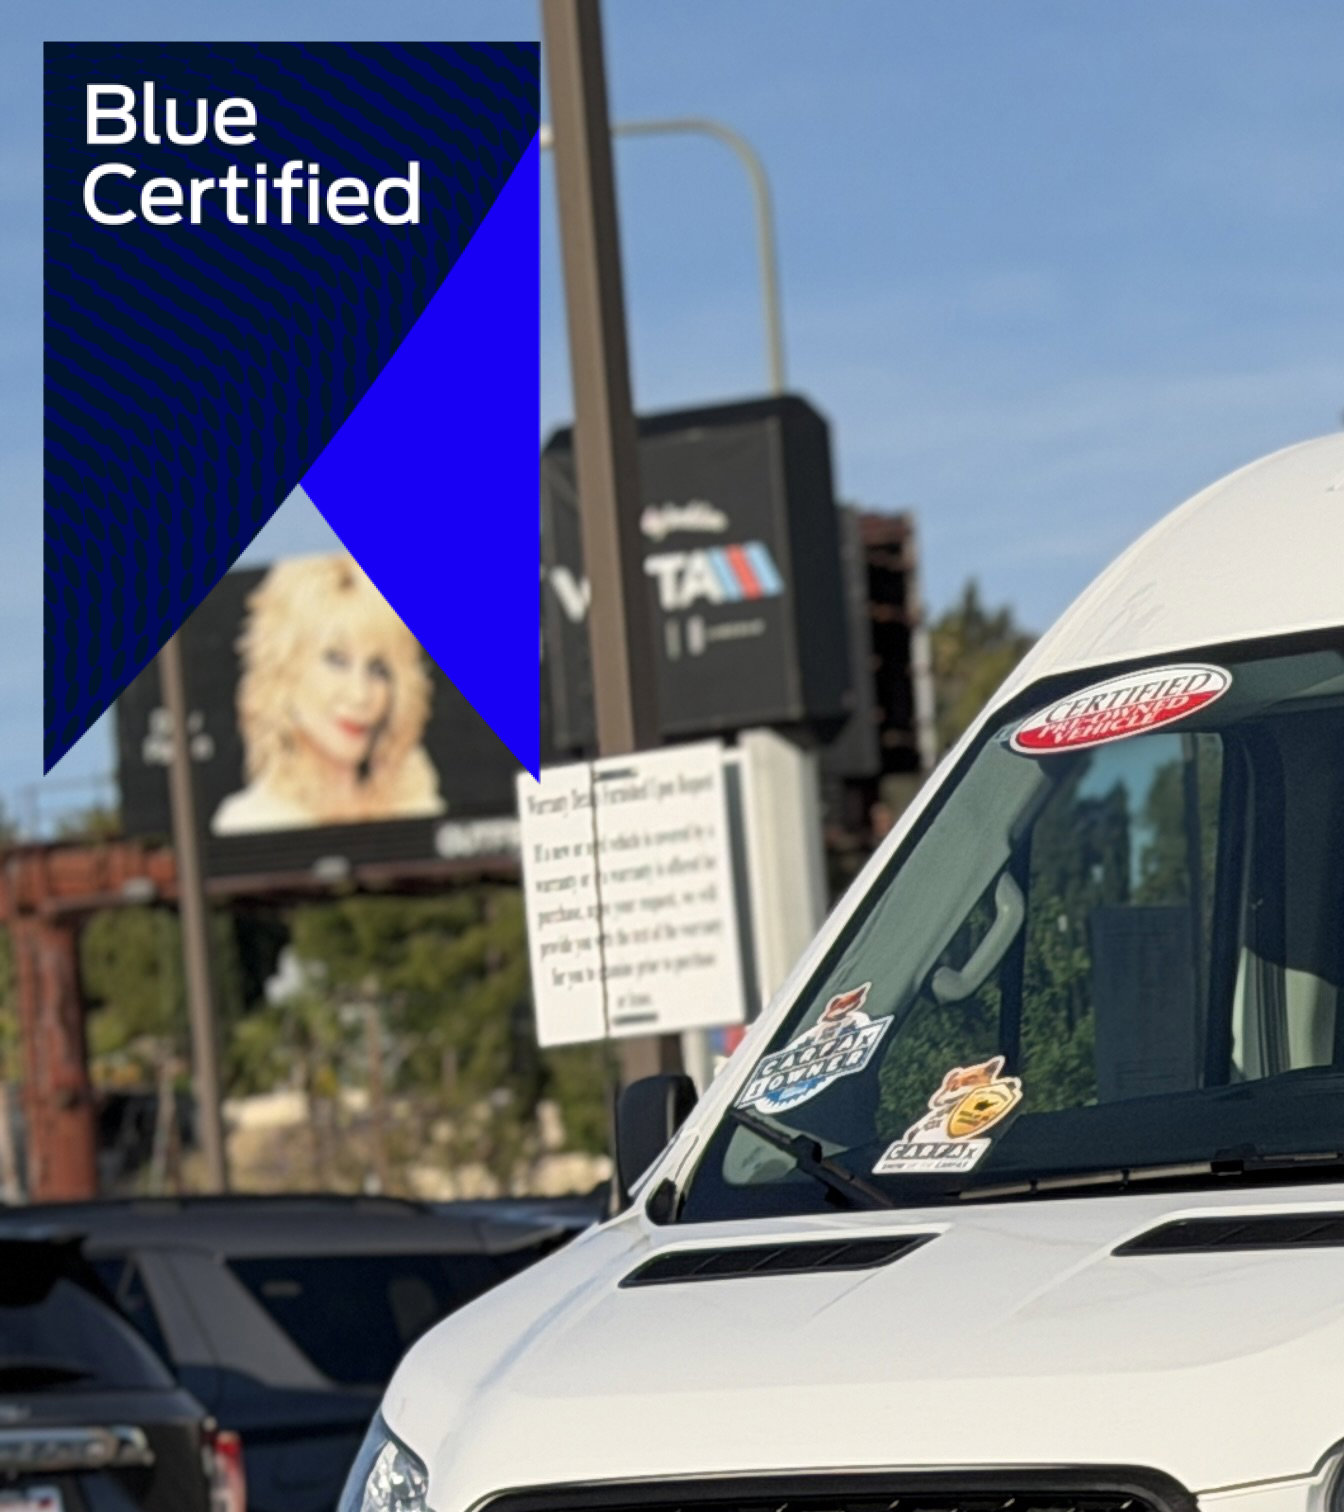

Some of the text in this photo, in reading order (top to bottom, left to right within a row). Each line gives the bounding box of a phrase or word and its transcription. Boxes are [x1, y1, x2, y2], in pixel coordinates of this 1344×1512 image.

[1037, 695, 1190, 739] PRE-OWNED
[1045, 673, 1212, 724] CERTIFIED
[1053, 711, 1161, 744] VEHICLE
[761, 1031, 876, 1076] CARFAX
[768, 1049, 864, 1091] OWNER
[890, 1143, 978, 1160] CARFAX
